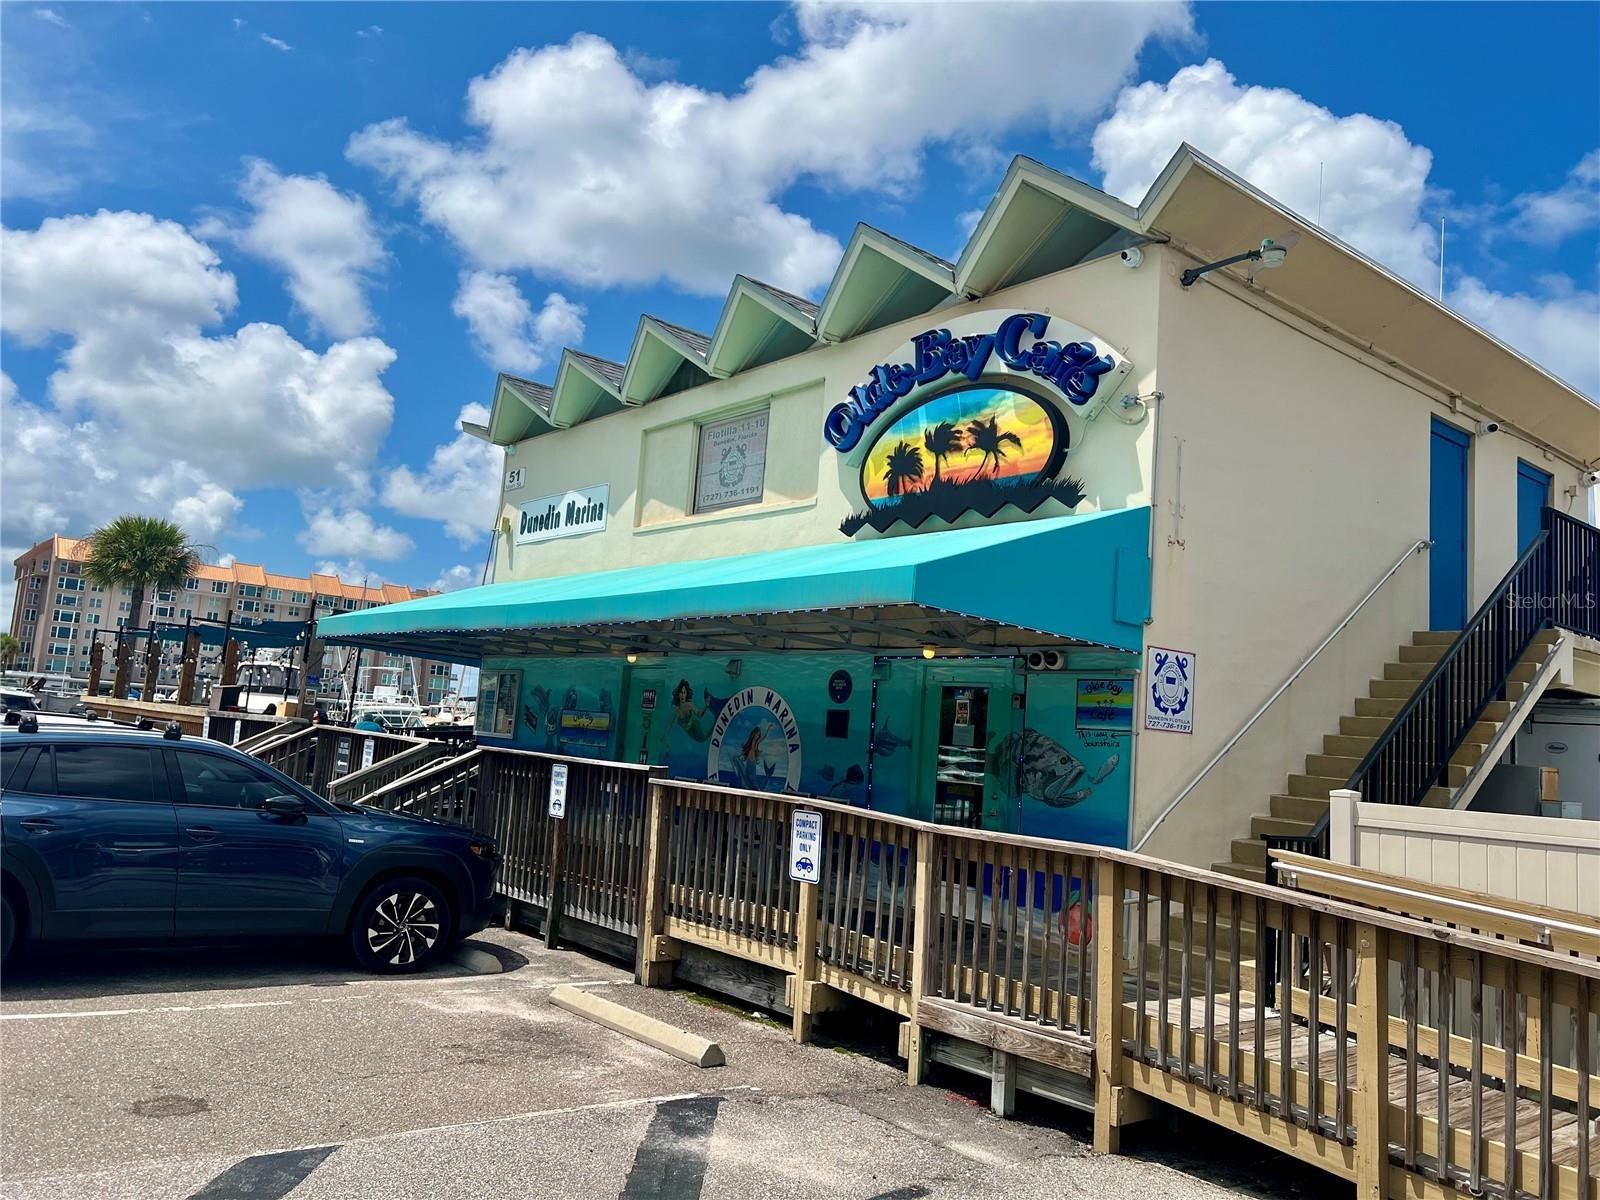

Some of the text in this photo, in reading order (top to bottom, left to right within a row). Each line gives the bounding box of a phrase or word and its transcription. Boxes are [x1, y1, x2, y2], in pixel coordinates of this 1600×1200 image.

[823, 362, 916, 453] Olde
[909, 327, 997, 387] Bay
[708, 417, 766, 441] Flotilla 11-10
[508, 468, 521, 484] 51
[703, 485, 760, 503] (727) 736-1191
[519, 496, 605, 536] Dunedin Marina
[1106, 680, 1124, 696] Bay
[711, 688, 800, 755] DUNEDIN MARINA
[1147, 720, 1190, 732] 727-736-1191
[795, 818, 818, 830] COMPACT
[795, 830, 817, 842] PARKING
[799, 842, 812, 853] ONLY
